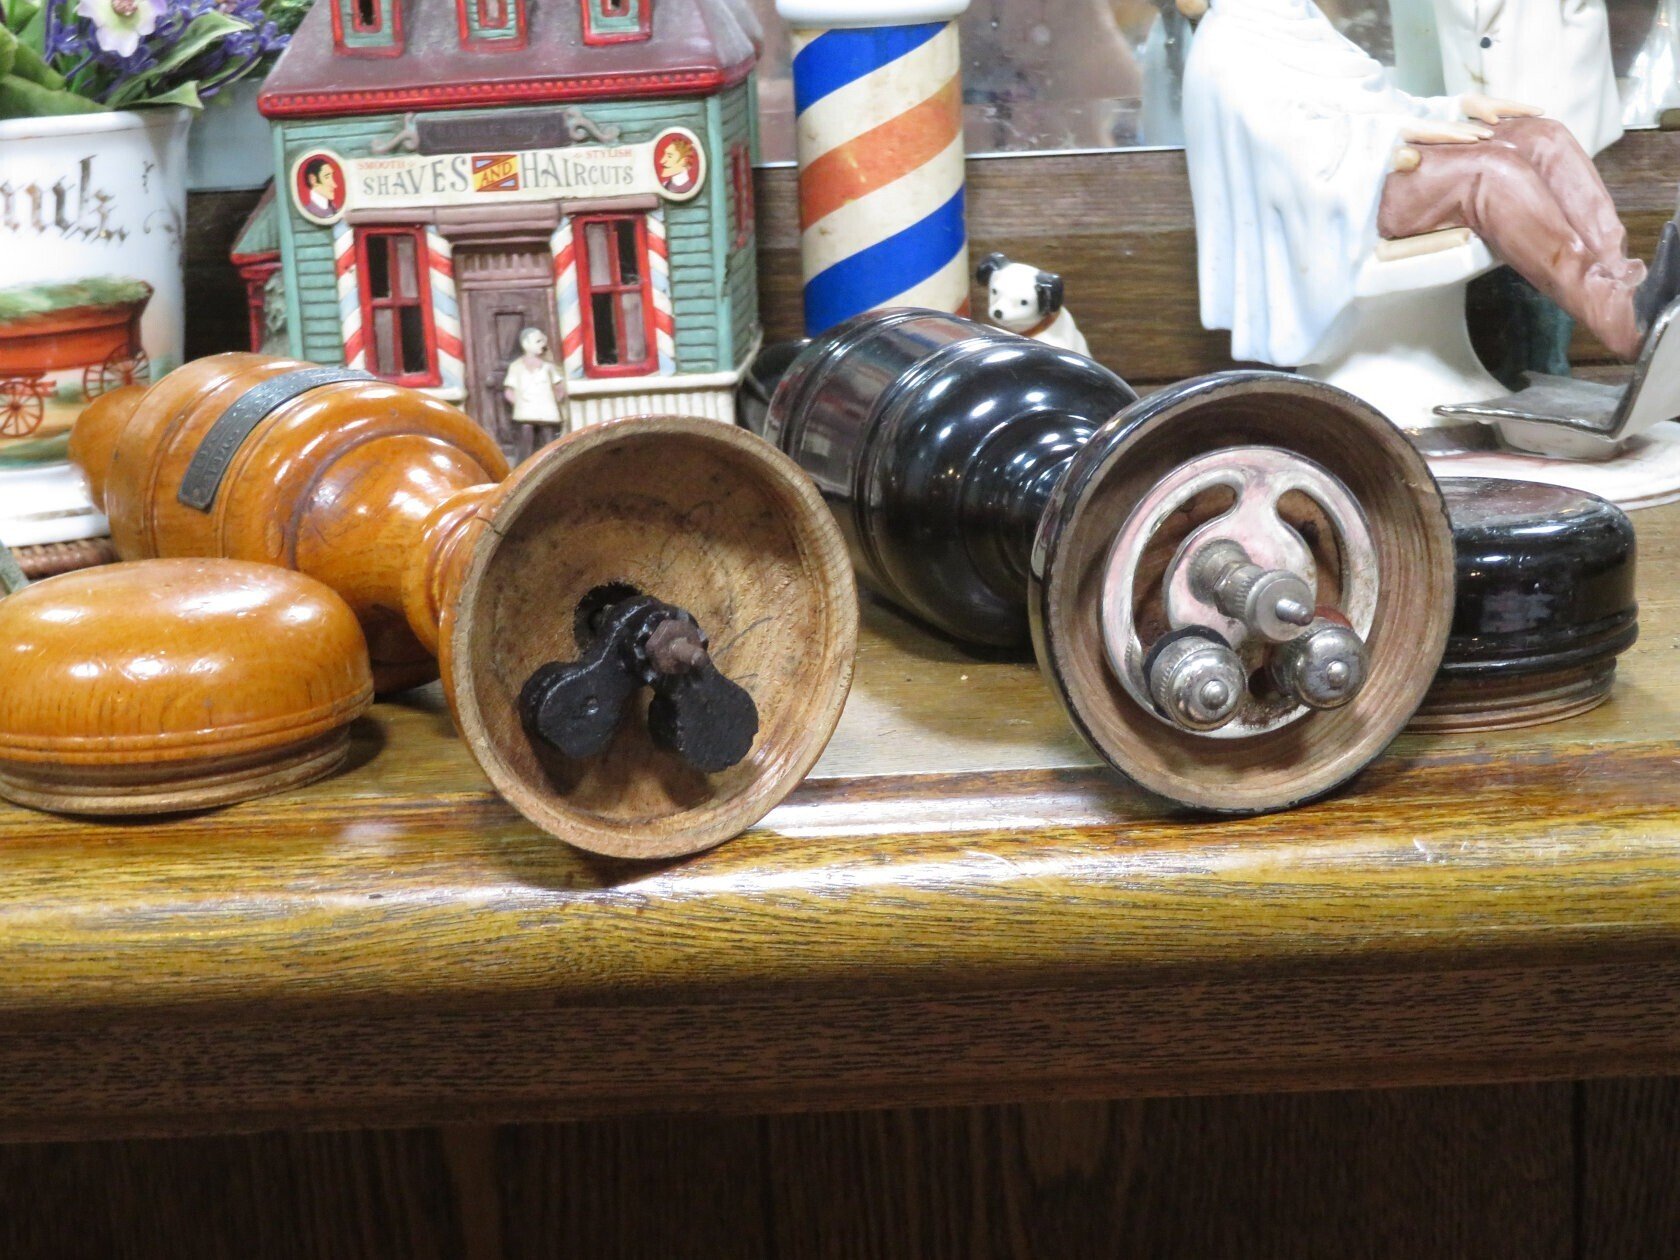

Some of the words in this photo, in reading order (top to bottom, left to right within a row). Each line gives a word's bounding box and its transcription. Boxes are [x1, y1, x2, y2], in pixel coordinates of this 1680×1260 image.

[587, 149, 632, 159] STYLISH
[358, 160, 406, 170] SMOOTH
[363, 155, 469, 195] SHAVES
[480, 161, 514, 187] AND
[521, 152, 634, 188] HAIRCUTS
